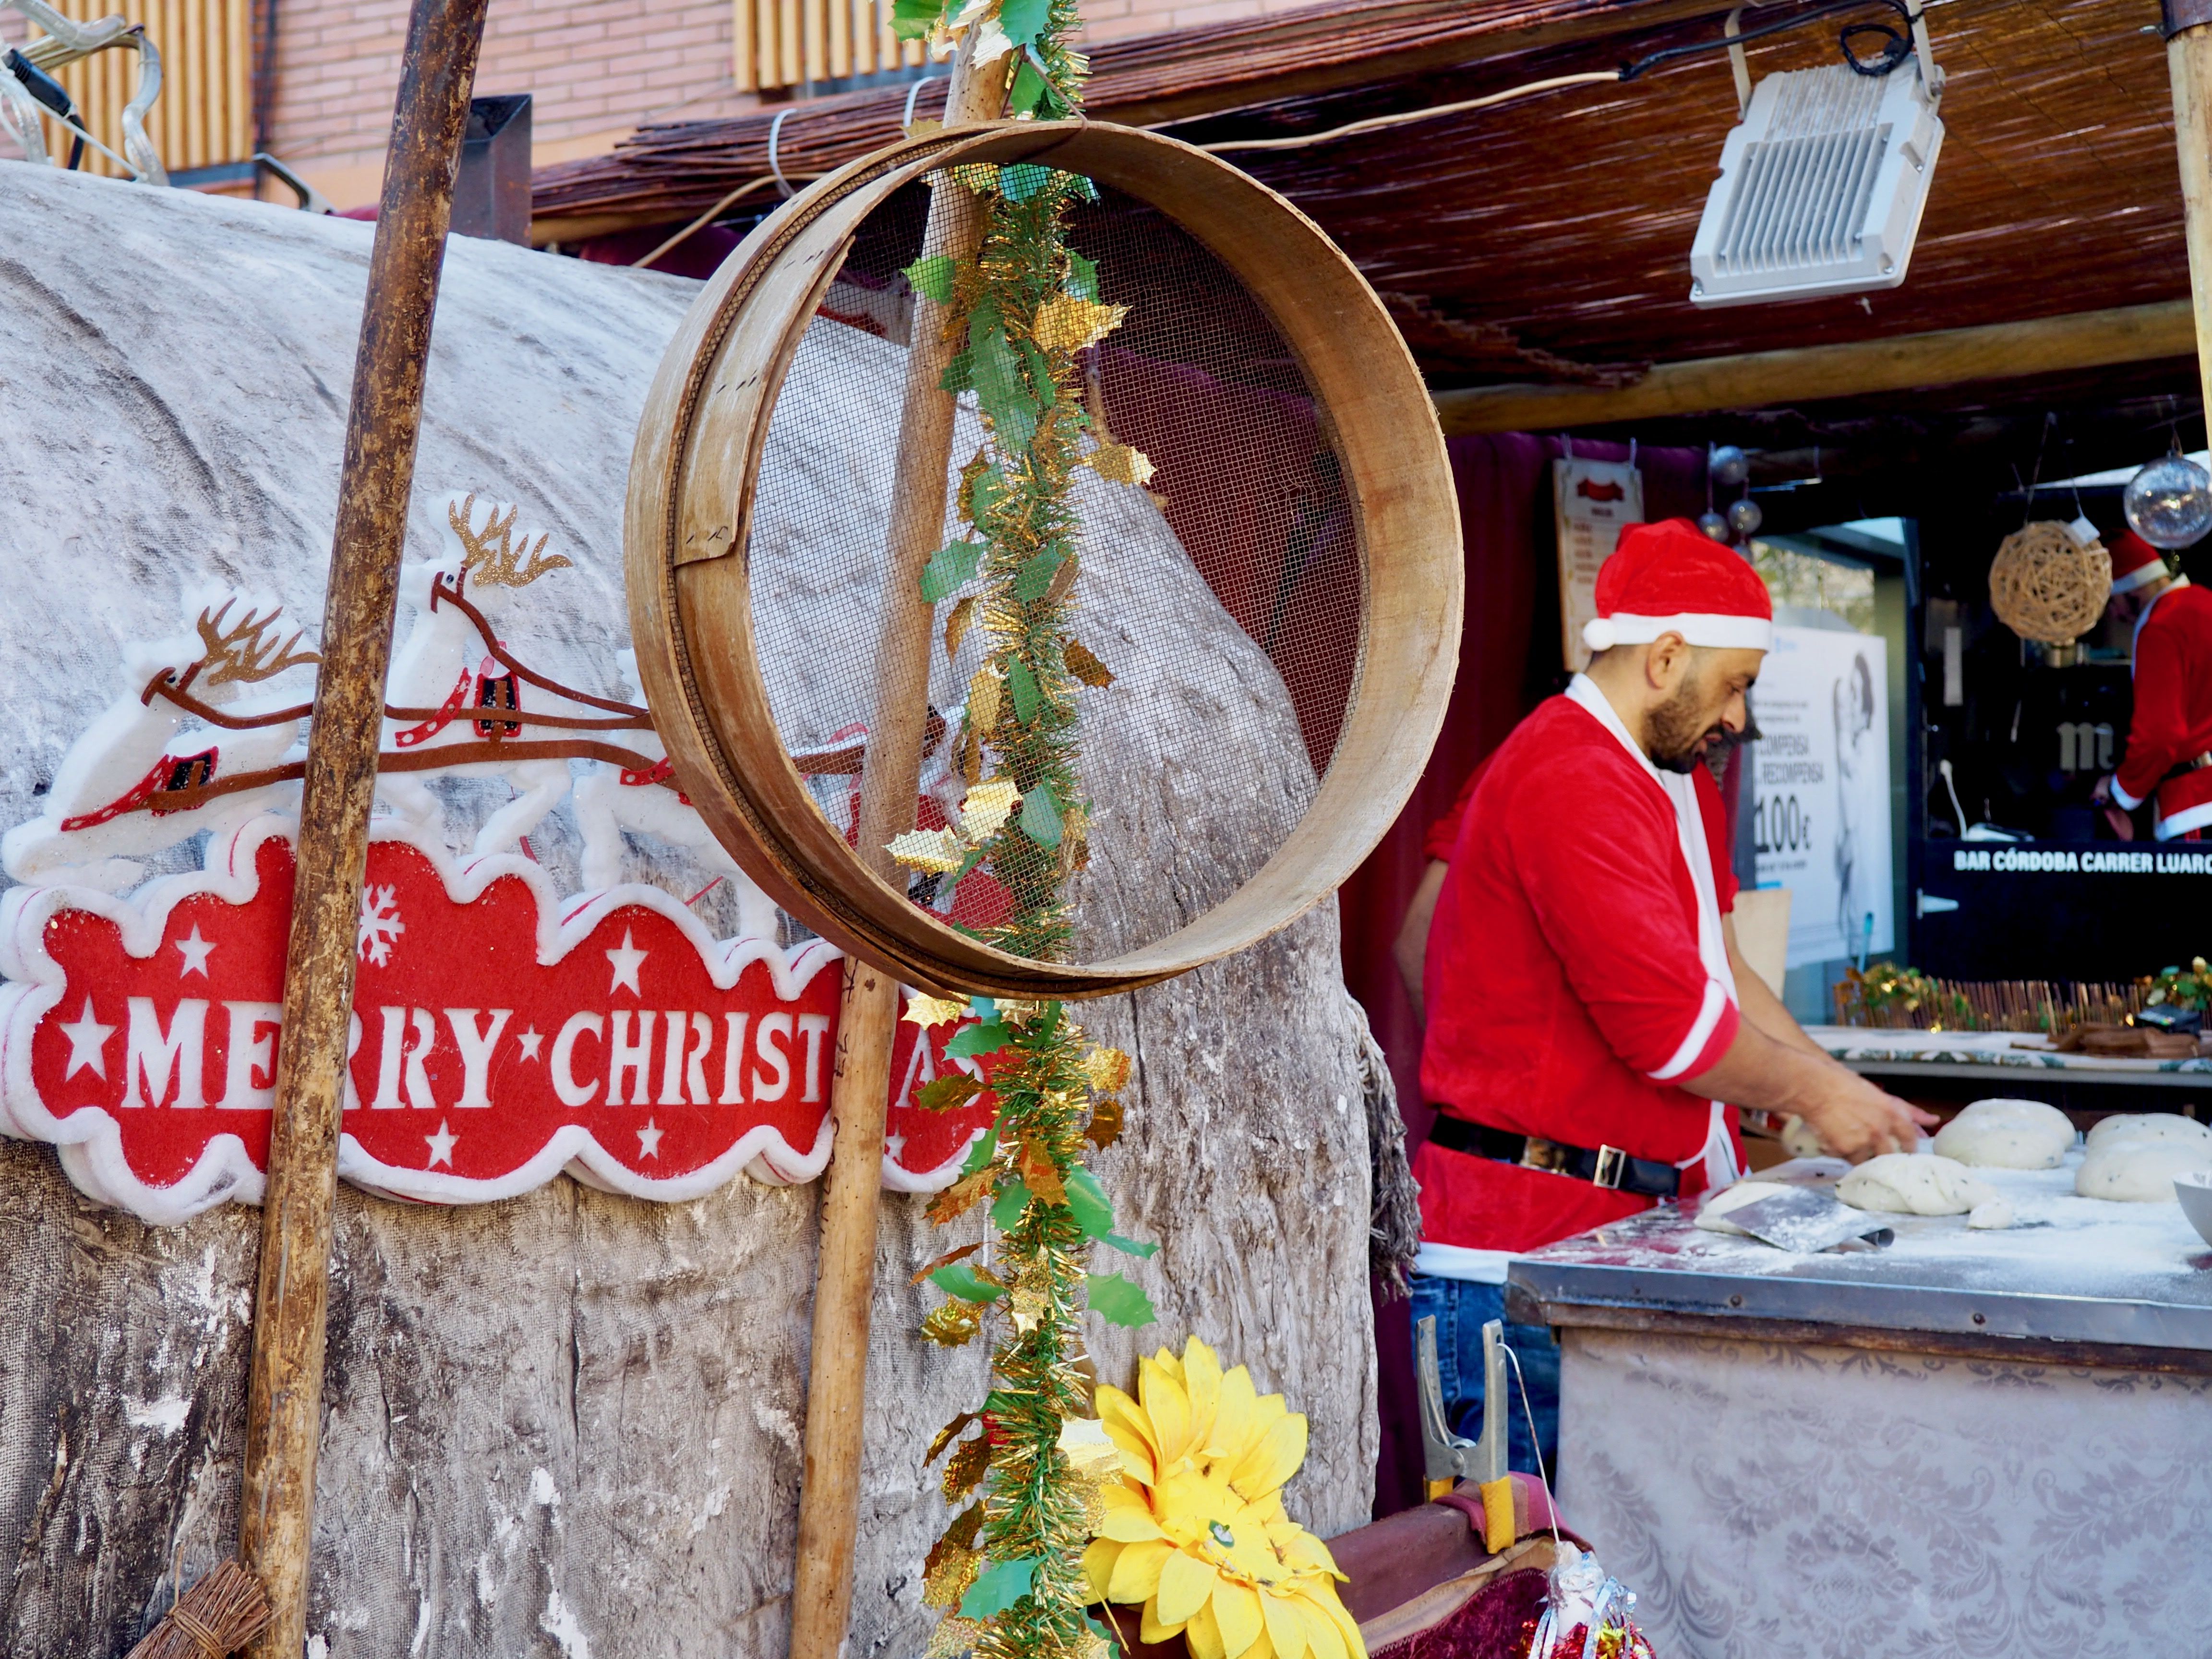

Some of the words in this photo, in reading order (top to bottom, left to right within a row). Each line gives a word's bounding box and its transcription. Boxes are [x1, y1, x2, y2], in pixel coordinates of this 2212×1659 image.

[1954, 850, 1991, 871] BAR
[1992, 846, 2079, 872] CÓRDOBA
[2080, 851, 2154, 873] CARRER
[550, 1009, 986, 1107] CHRISTA
